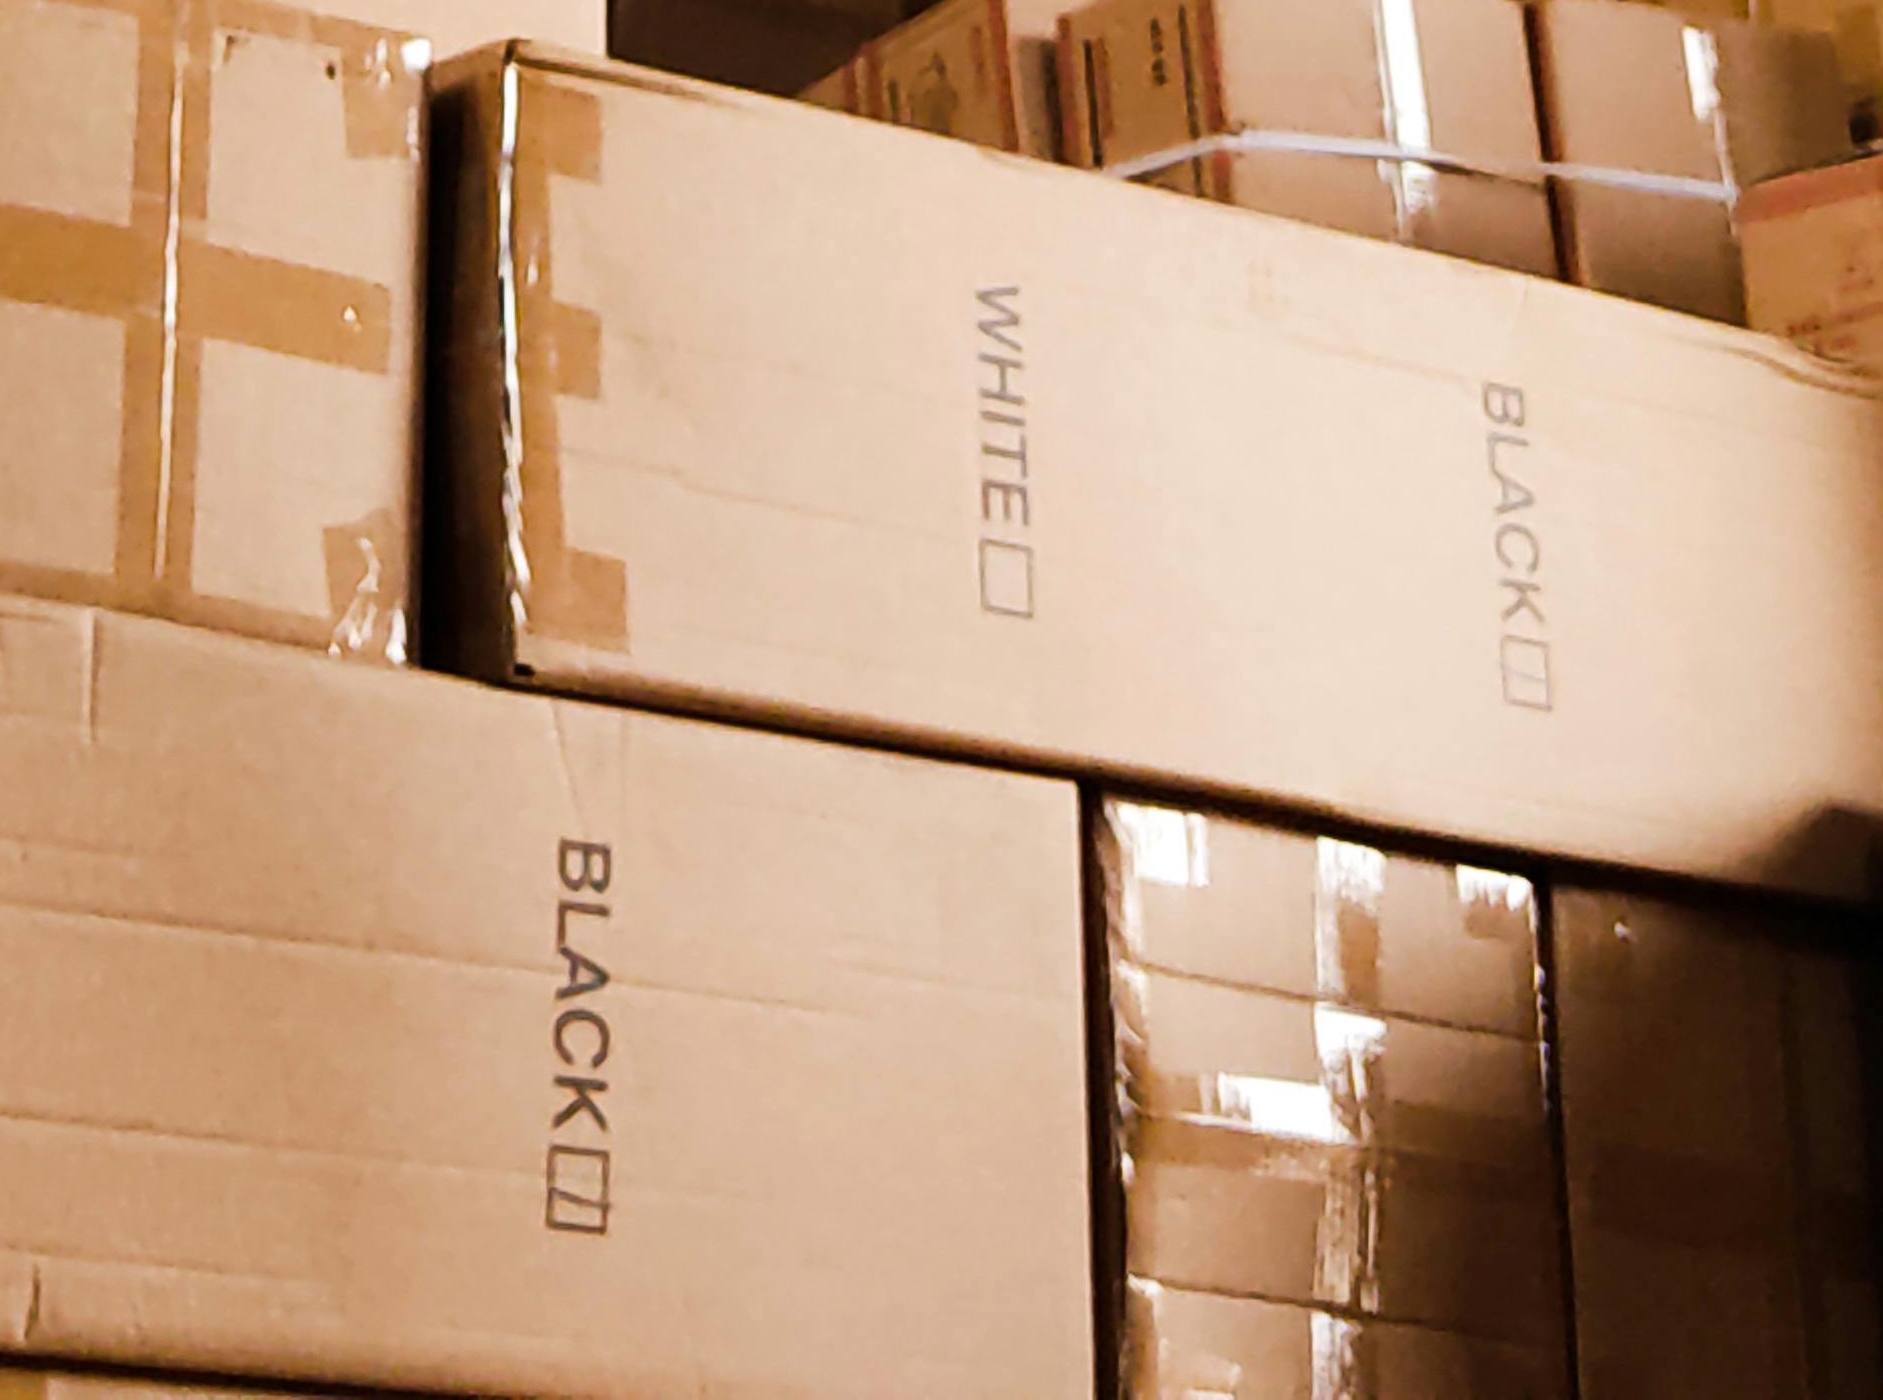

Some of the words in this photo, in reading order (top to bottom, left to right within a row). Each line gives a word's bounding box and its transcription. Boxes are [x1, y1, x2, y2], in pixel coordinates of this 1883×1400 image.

[976, 287, 1030, 527] WHITE
[1482, 381, 1546, 624] BLACK
[552, 839, 611, 1132] BLACK
